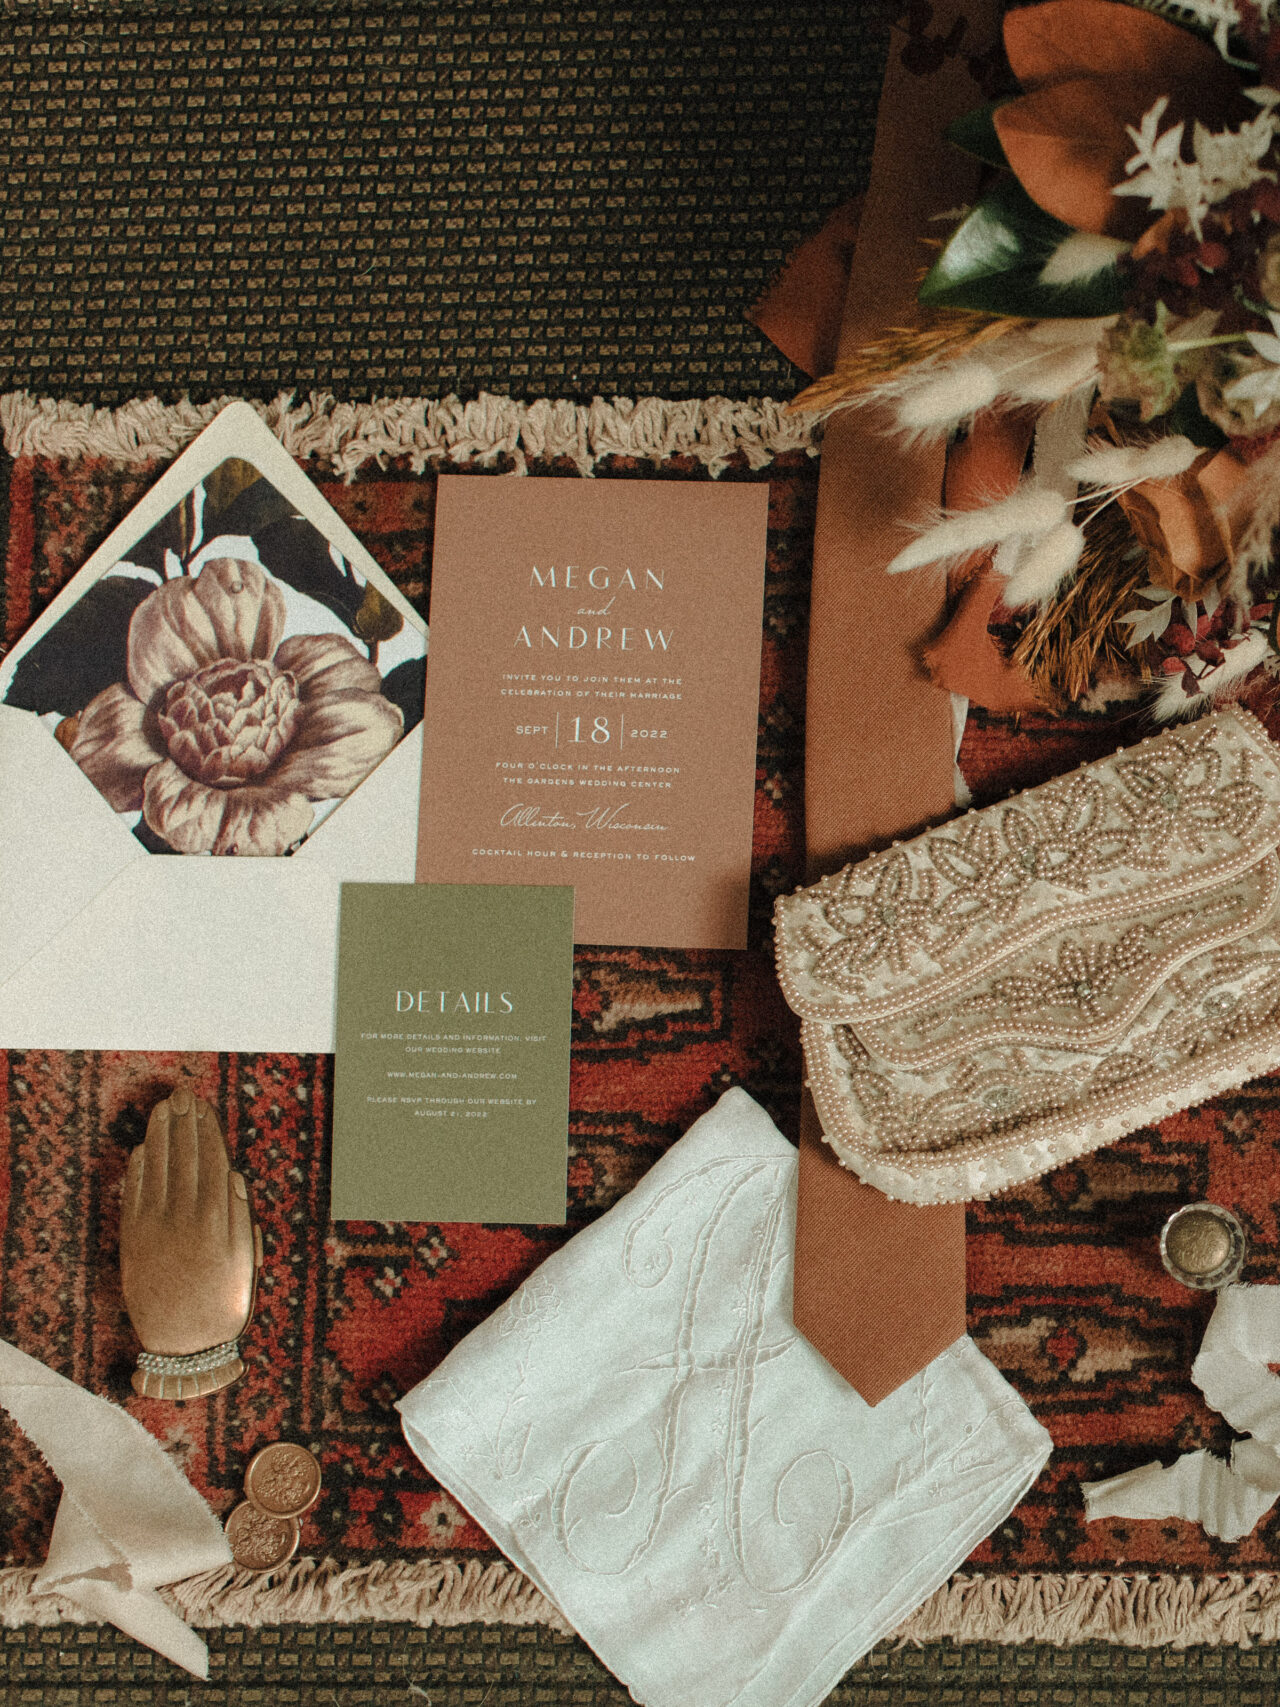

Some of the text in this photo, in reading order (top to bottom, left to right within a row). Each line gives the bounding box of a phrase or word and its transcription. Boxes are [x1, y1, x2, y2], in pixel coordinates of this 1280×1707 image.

[529, 566, 665, 590] MEGAN
[577, 596, 616, 615] and
[513, 625, 674, 650] ANDREW
[630, 692, 682, 700] MARRIAGE
[516, 716, 668, 743] SEPT 18 2022
[528, 762, 573, 770] O'CLOCK
[527, 778, 575, 786] GARDENS
[579, 779, 626, 787] WEDDING
[499, 803, 669, 831] Allenton, Wisconsin
[573, 851, 631, 860] RECEPTION
[396, 990, 513, 1014] DETAILS
